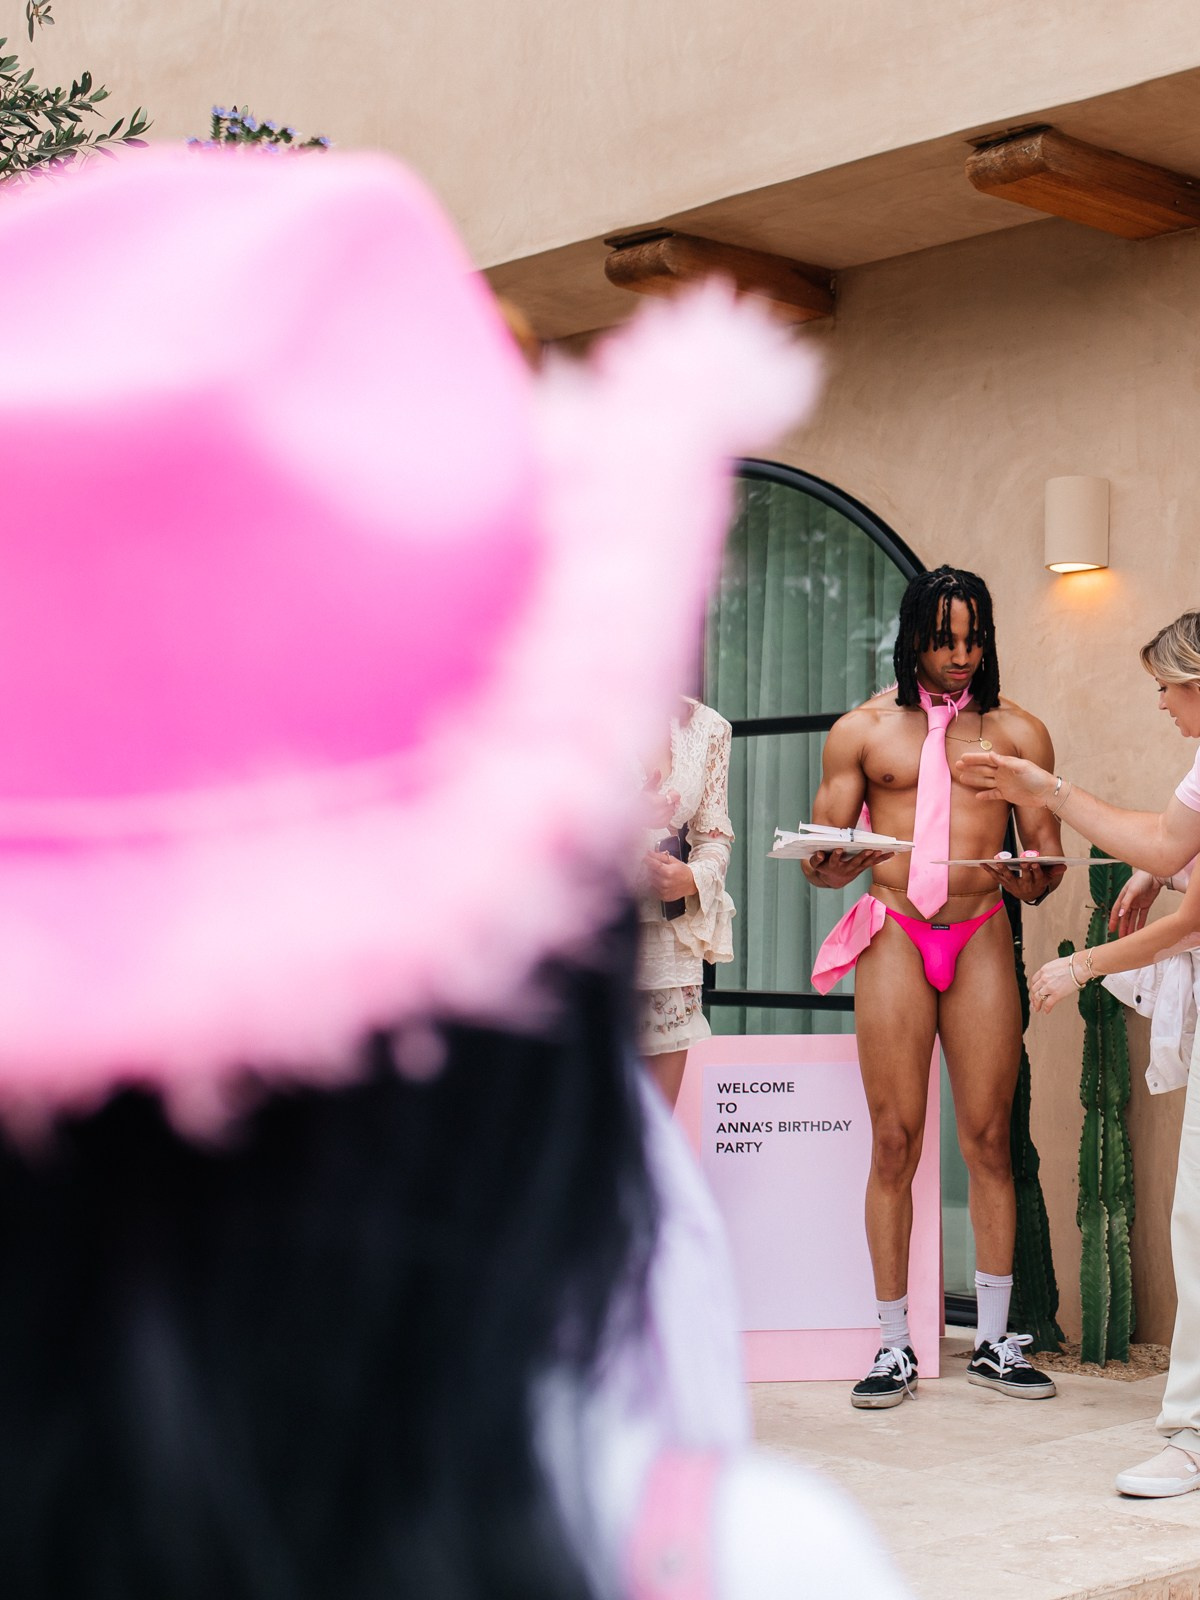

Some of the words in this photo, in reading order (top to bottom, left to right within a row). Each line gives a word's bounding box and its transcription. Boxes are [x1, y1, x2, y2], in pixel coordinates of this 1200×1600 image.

[717, 1081, 795, 1094] WELCOME
[717, 1102, 737, 1114] TO
[716, 1121, 773, 1134] ANNA'S
[778, 1120, 852, 1133] BIRTHDAY
[716, 1141, 763, 1153] PARTY
